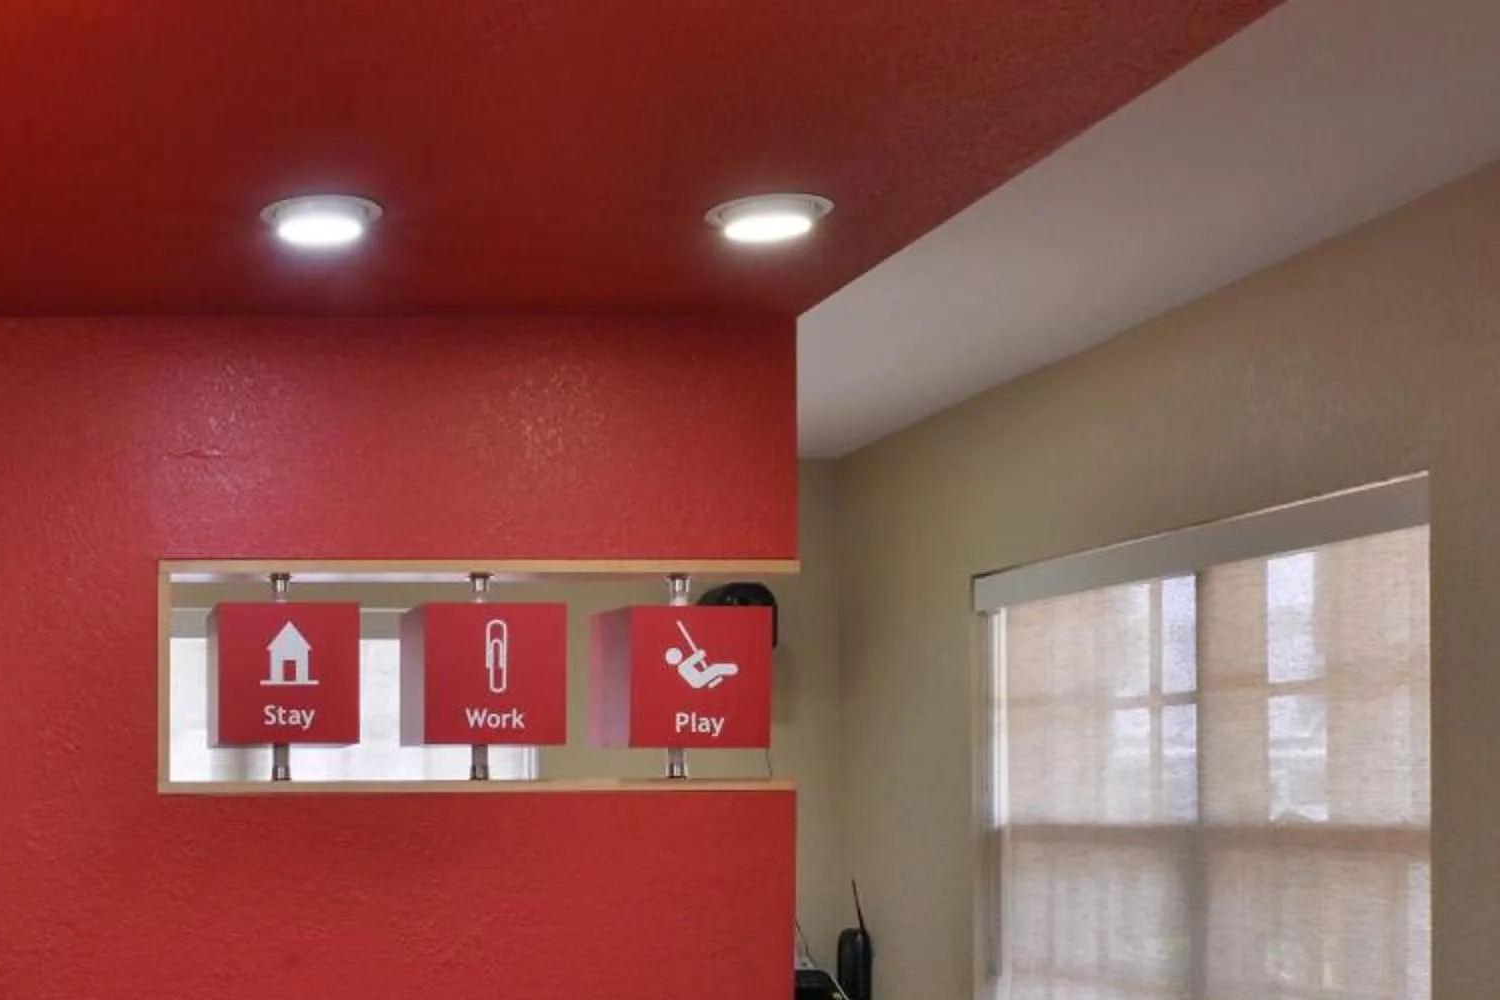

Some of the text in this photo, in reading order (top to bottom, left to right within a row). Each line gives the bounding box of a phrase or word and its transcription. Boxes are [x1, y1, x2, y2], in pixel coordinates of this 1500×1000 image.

[263, 704, 315, 730] Stay
[465, 707, 525, 730] Work
[674, 712, 725, 737] Play
